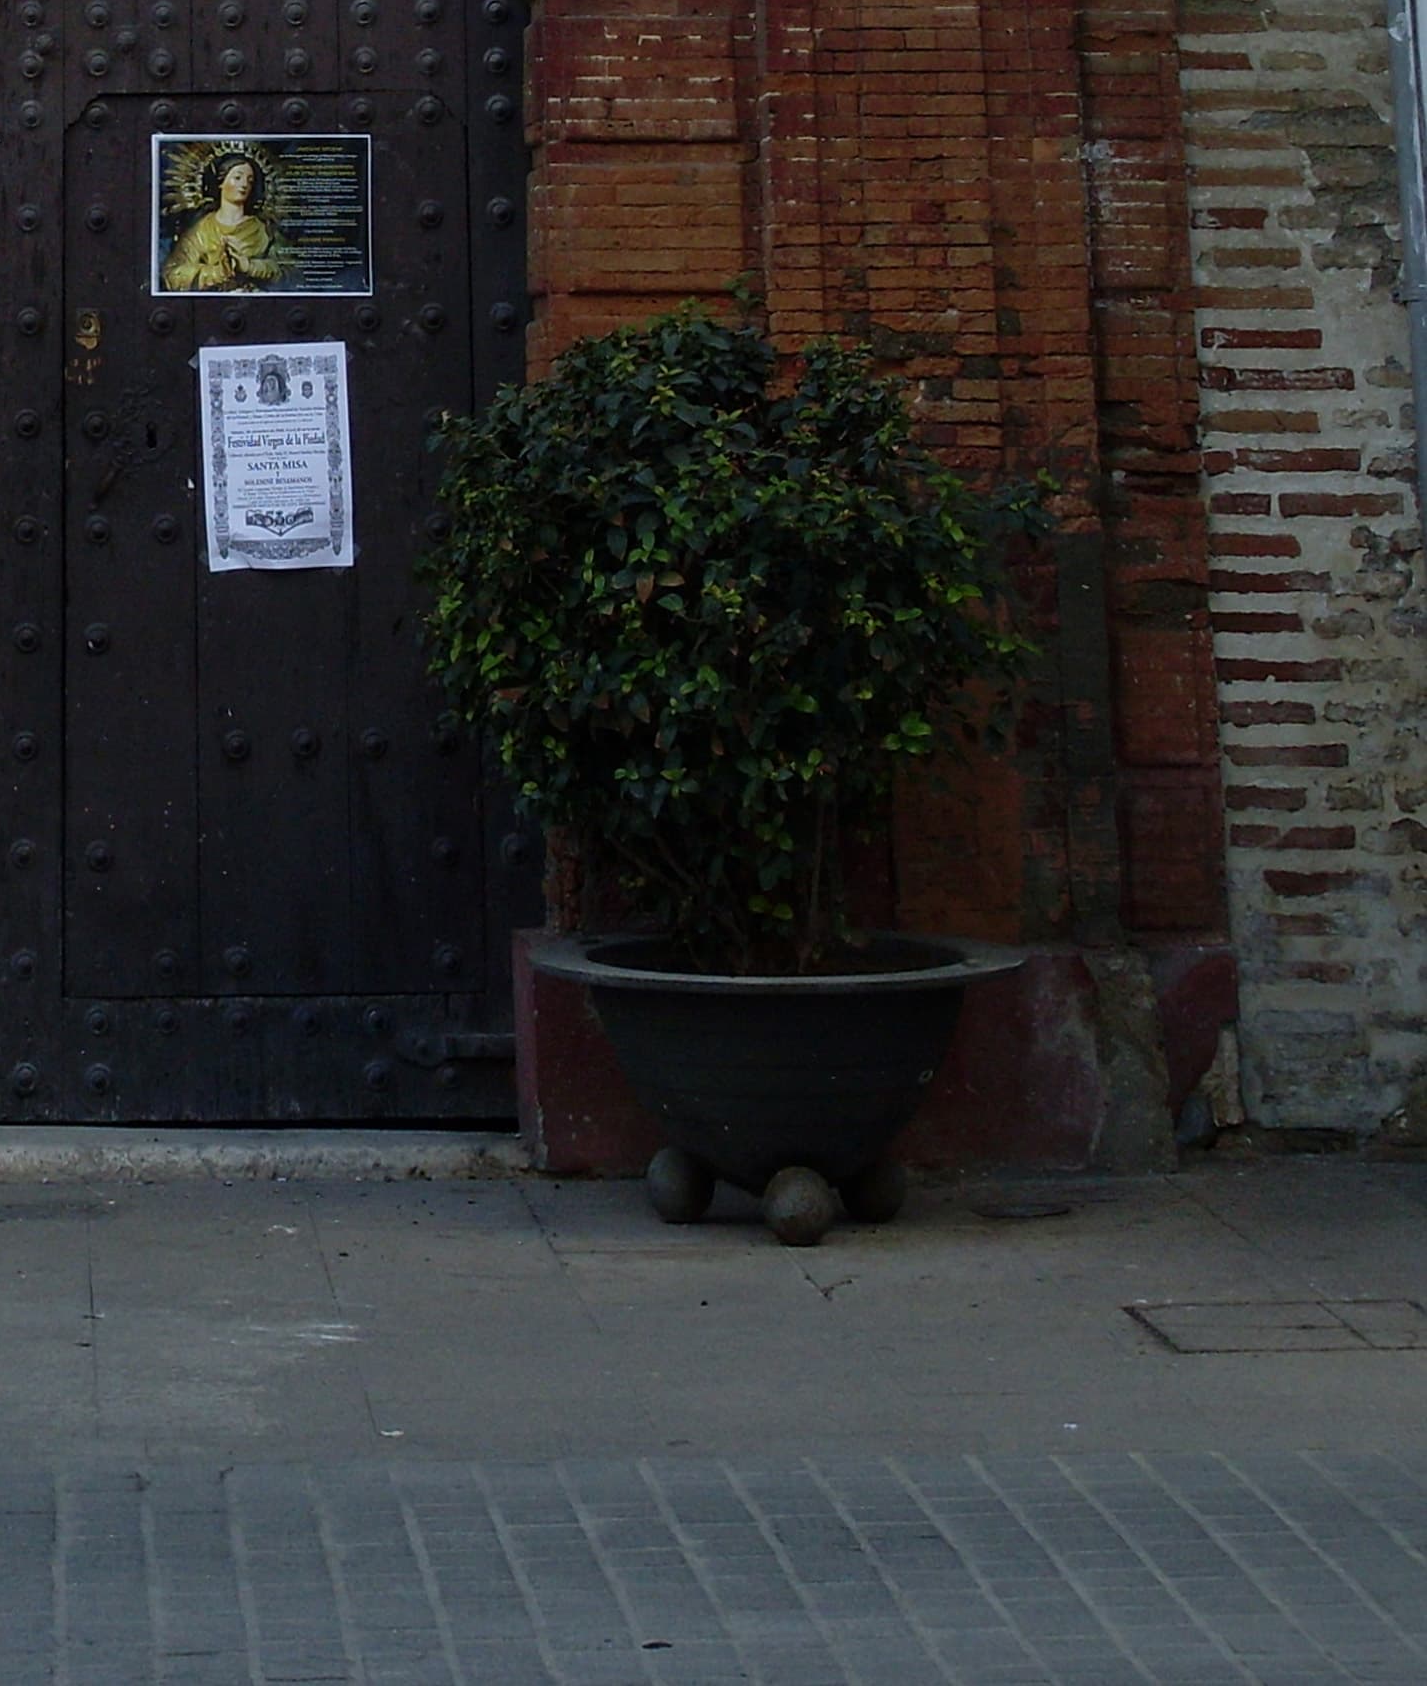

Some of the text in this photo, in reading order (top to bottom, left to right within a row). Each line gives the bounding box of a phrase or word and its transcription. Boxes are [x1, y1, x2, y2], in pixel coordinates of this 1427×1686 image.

[227, 434, 261, 448] Festividad
[262, 433, 284, 450] Virgen
[247, 459, 309, 471] SANTA MISA
